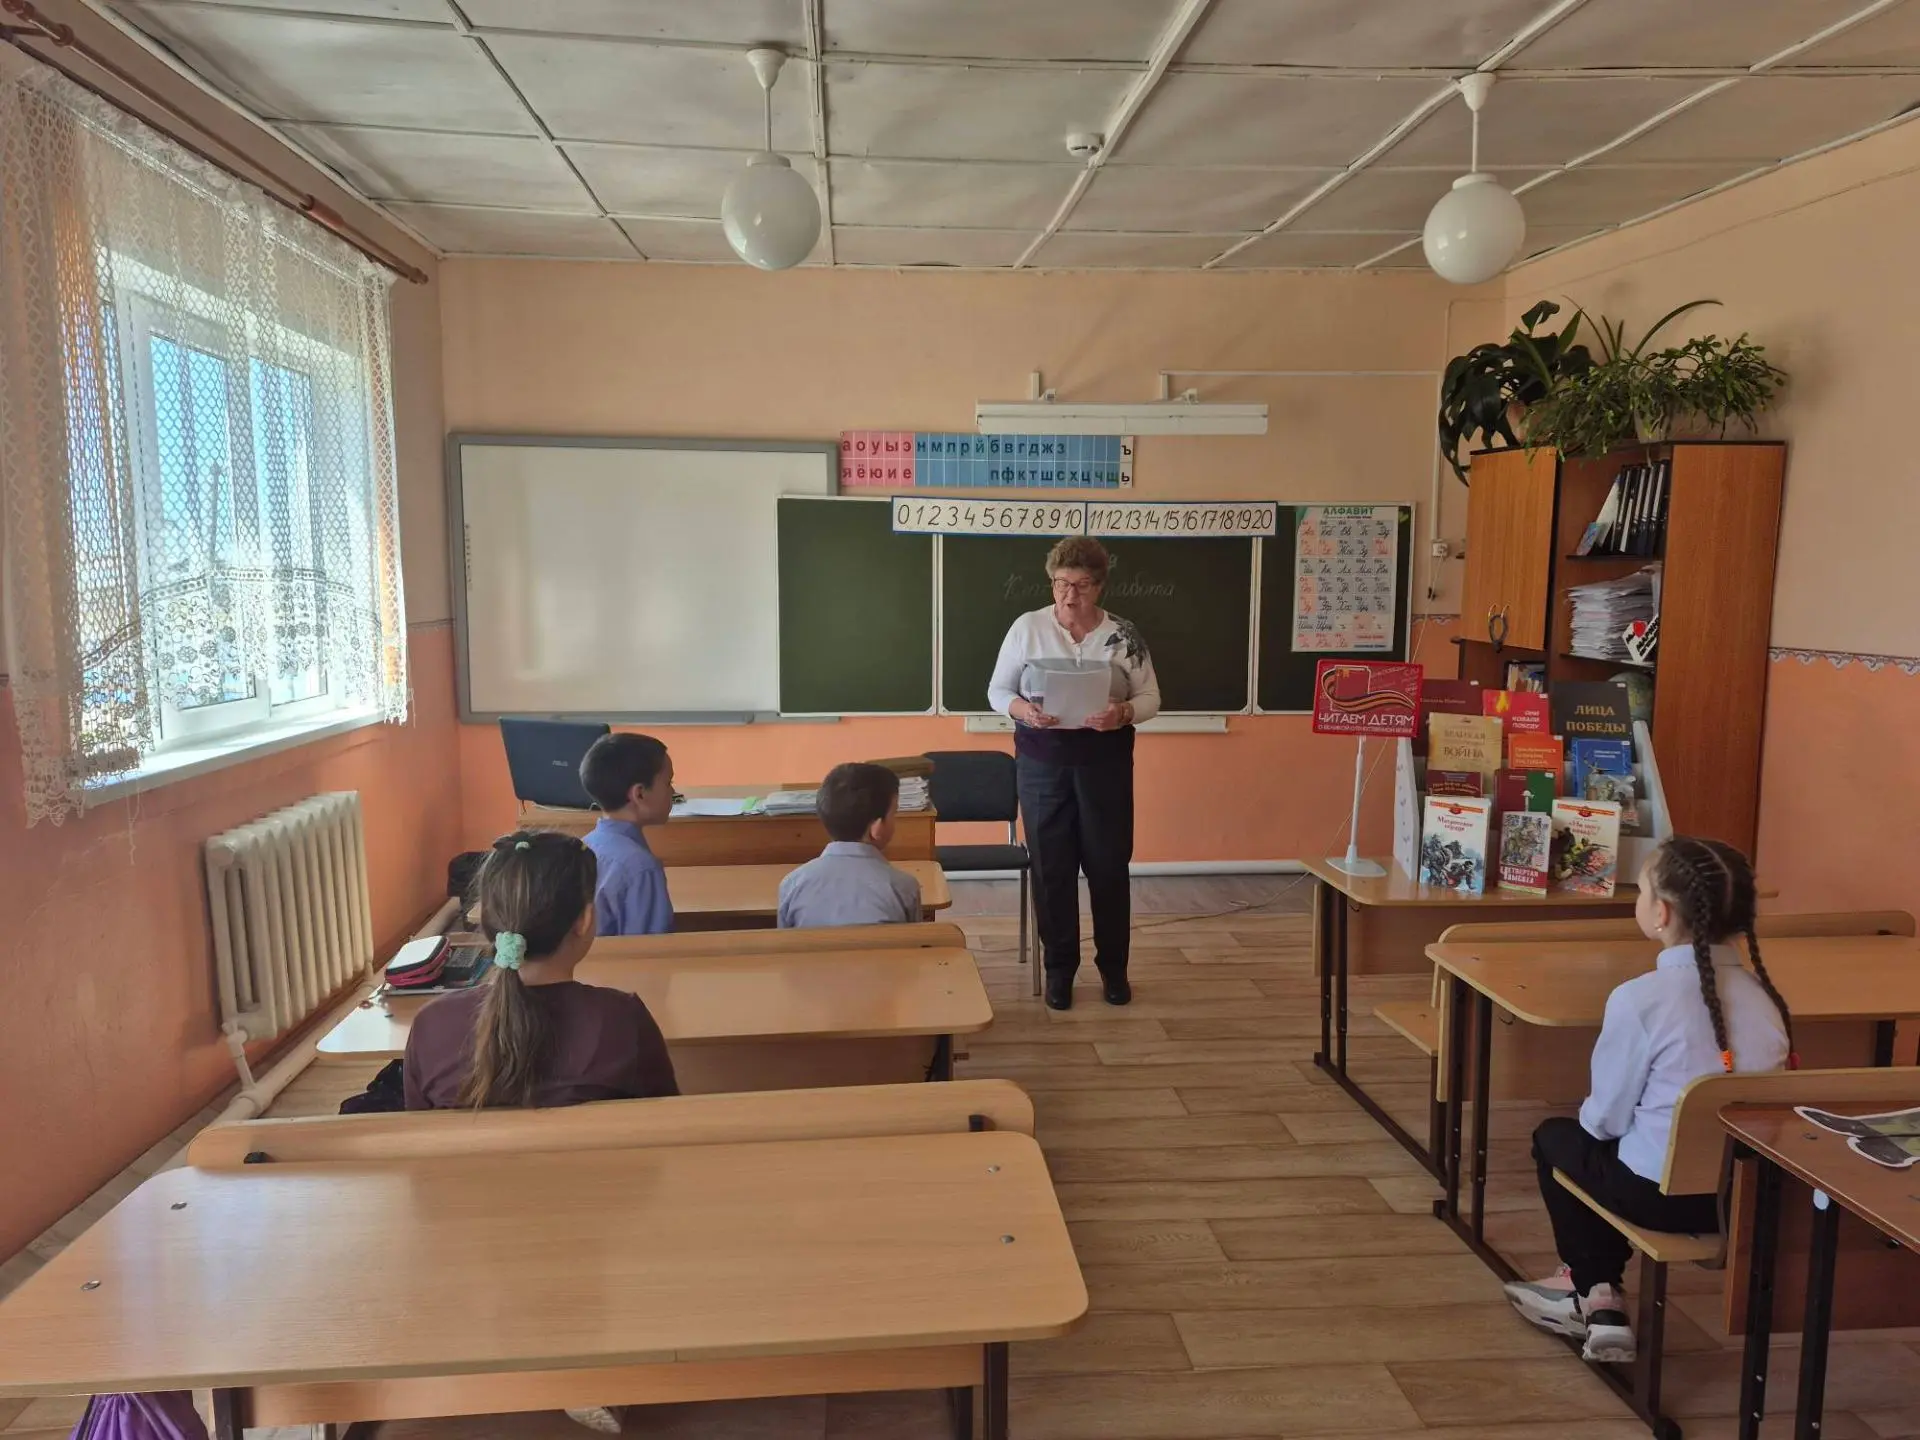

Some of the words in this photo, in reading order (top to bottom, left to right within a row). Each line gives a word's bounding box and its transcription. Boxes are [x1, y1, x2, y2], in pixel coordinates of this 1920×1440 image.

[898, 504, 909, 525] 0
[916, 505, 925, 525] 1
[928, 505, 941, 526] 2
[947, 506, 959, 526] 3
[964, 507, 975, 527] 4
[982, 508, 995, 527] 5
[1000, 508, 1013, 528] 6
[1017, 508, 1029, 528] 7
[1032, 508, 1045, 528] 8
[1048, 508, 1061, 529] 9
[1064, 509, 1082, 529] 10
[1323, 507, 1375, 515] АЛФАВИТ
[1090, 510, 1104, 529] 11
[1105, 510, 1123, 530] 12
[1125, 510, 1141, 530] 13
[1144, 510, 1160, 530] 14
[1163, 510, 1180, 530] 15
[1182, 510, 1198, 530] 16
[1201, 510, 1218, 530] 17
[1219, 510, 1234, 530] 18
[1236, 509, 1252, 529] 19
[1251, 509, 1273, 529] 20
[1574, 704, 1615, 717] ЛИЦА
[1318, 712, 1365, 724] ЧИТАЕМ
[1368, 714, 1415, 726] ДЕТЯМ
[1566, 721, 1626, 734] ПОБЕДЫ
[1444, 746, 1484, 758] ВОЙНА
